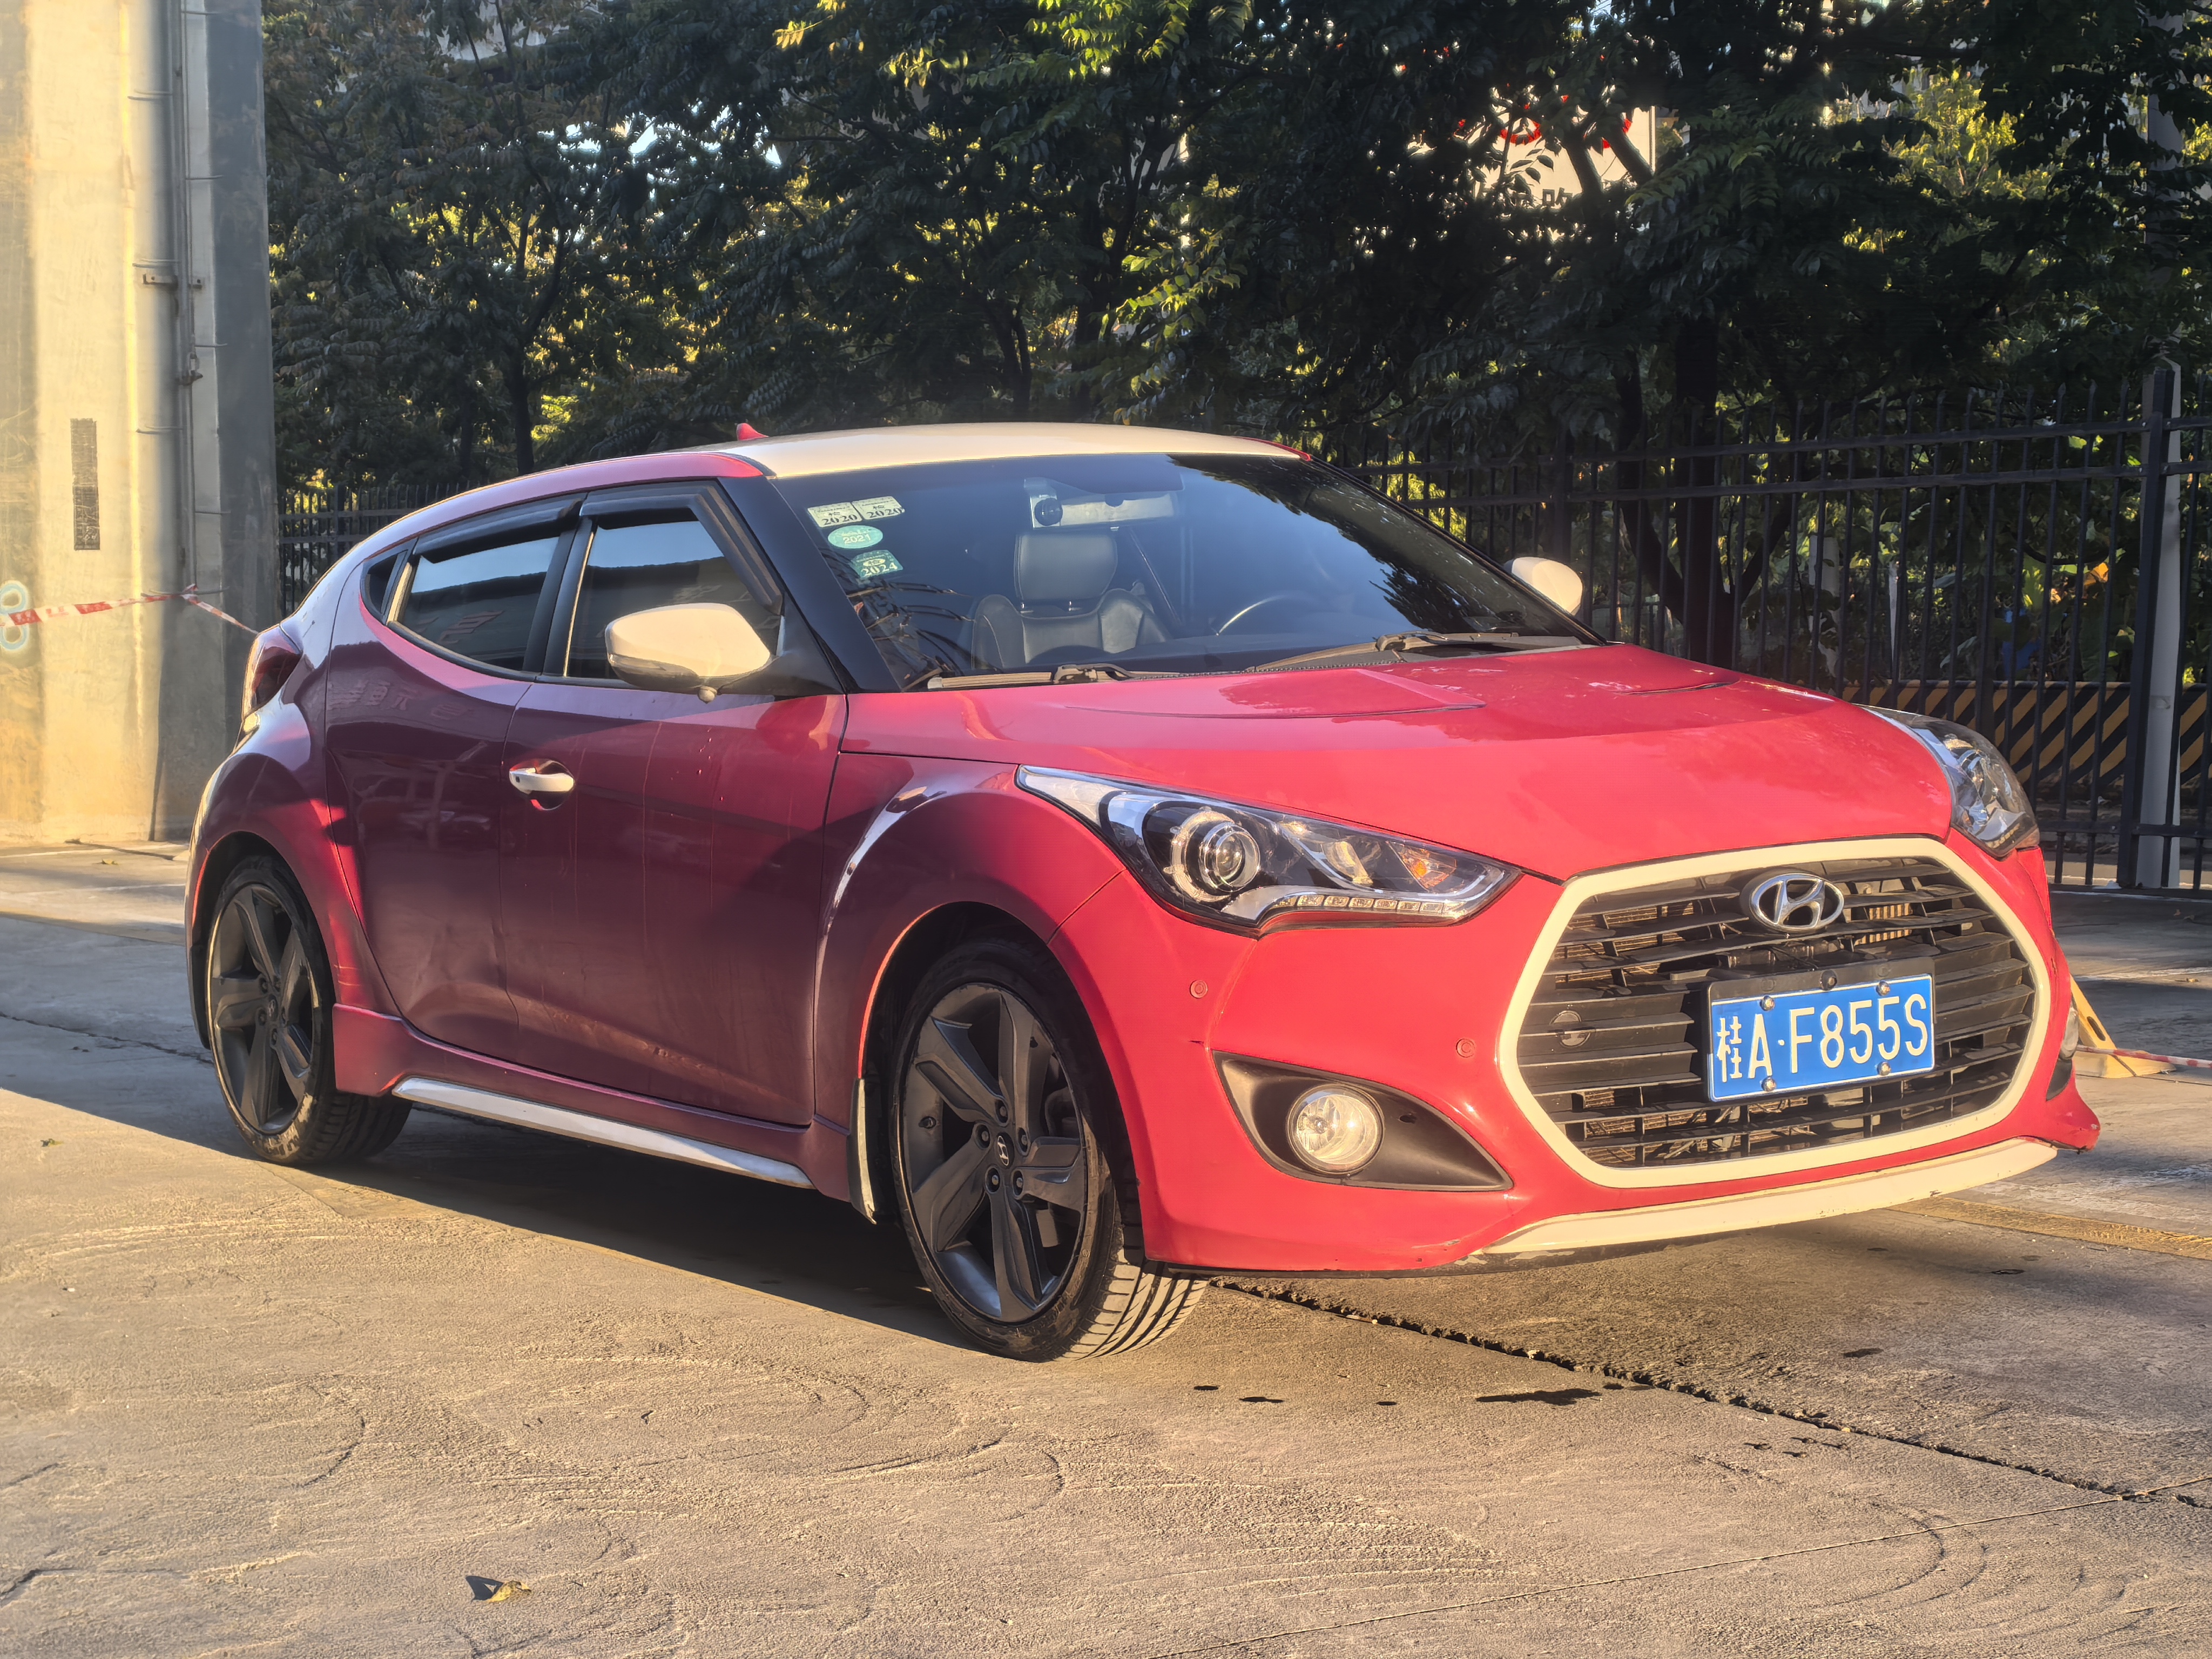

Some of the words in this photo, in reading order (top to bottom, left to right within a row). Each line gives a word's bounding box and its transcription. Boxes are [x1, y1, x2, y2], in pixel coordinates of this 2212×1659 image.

[822, 514, 858, 525] 2020
[843, 534, 871, 544] 2021
[861, 562, 898, 577] 2024
